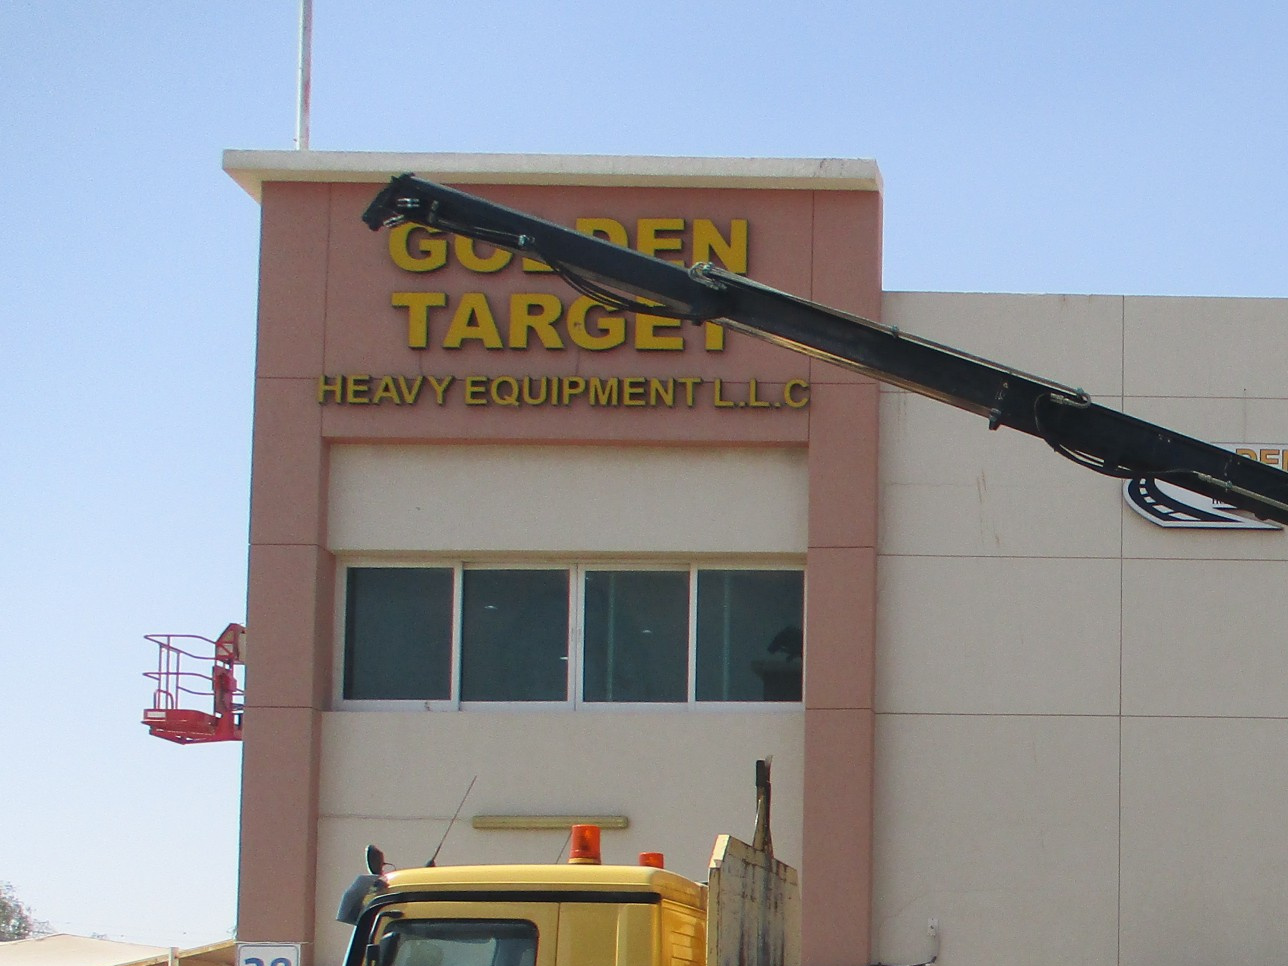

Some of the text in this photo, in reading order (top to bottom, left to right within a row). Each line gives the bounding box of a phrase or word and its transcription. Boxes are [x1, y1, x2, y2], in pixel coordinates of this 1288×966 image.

[318, 374, 810, 409] HEAVY EQUIPMENT L.L.C
